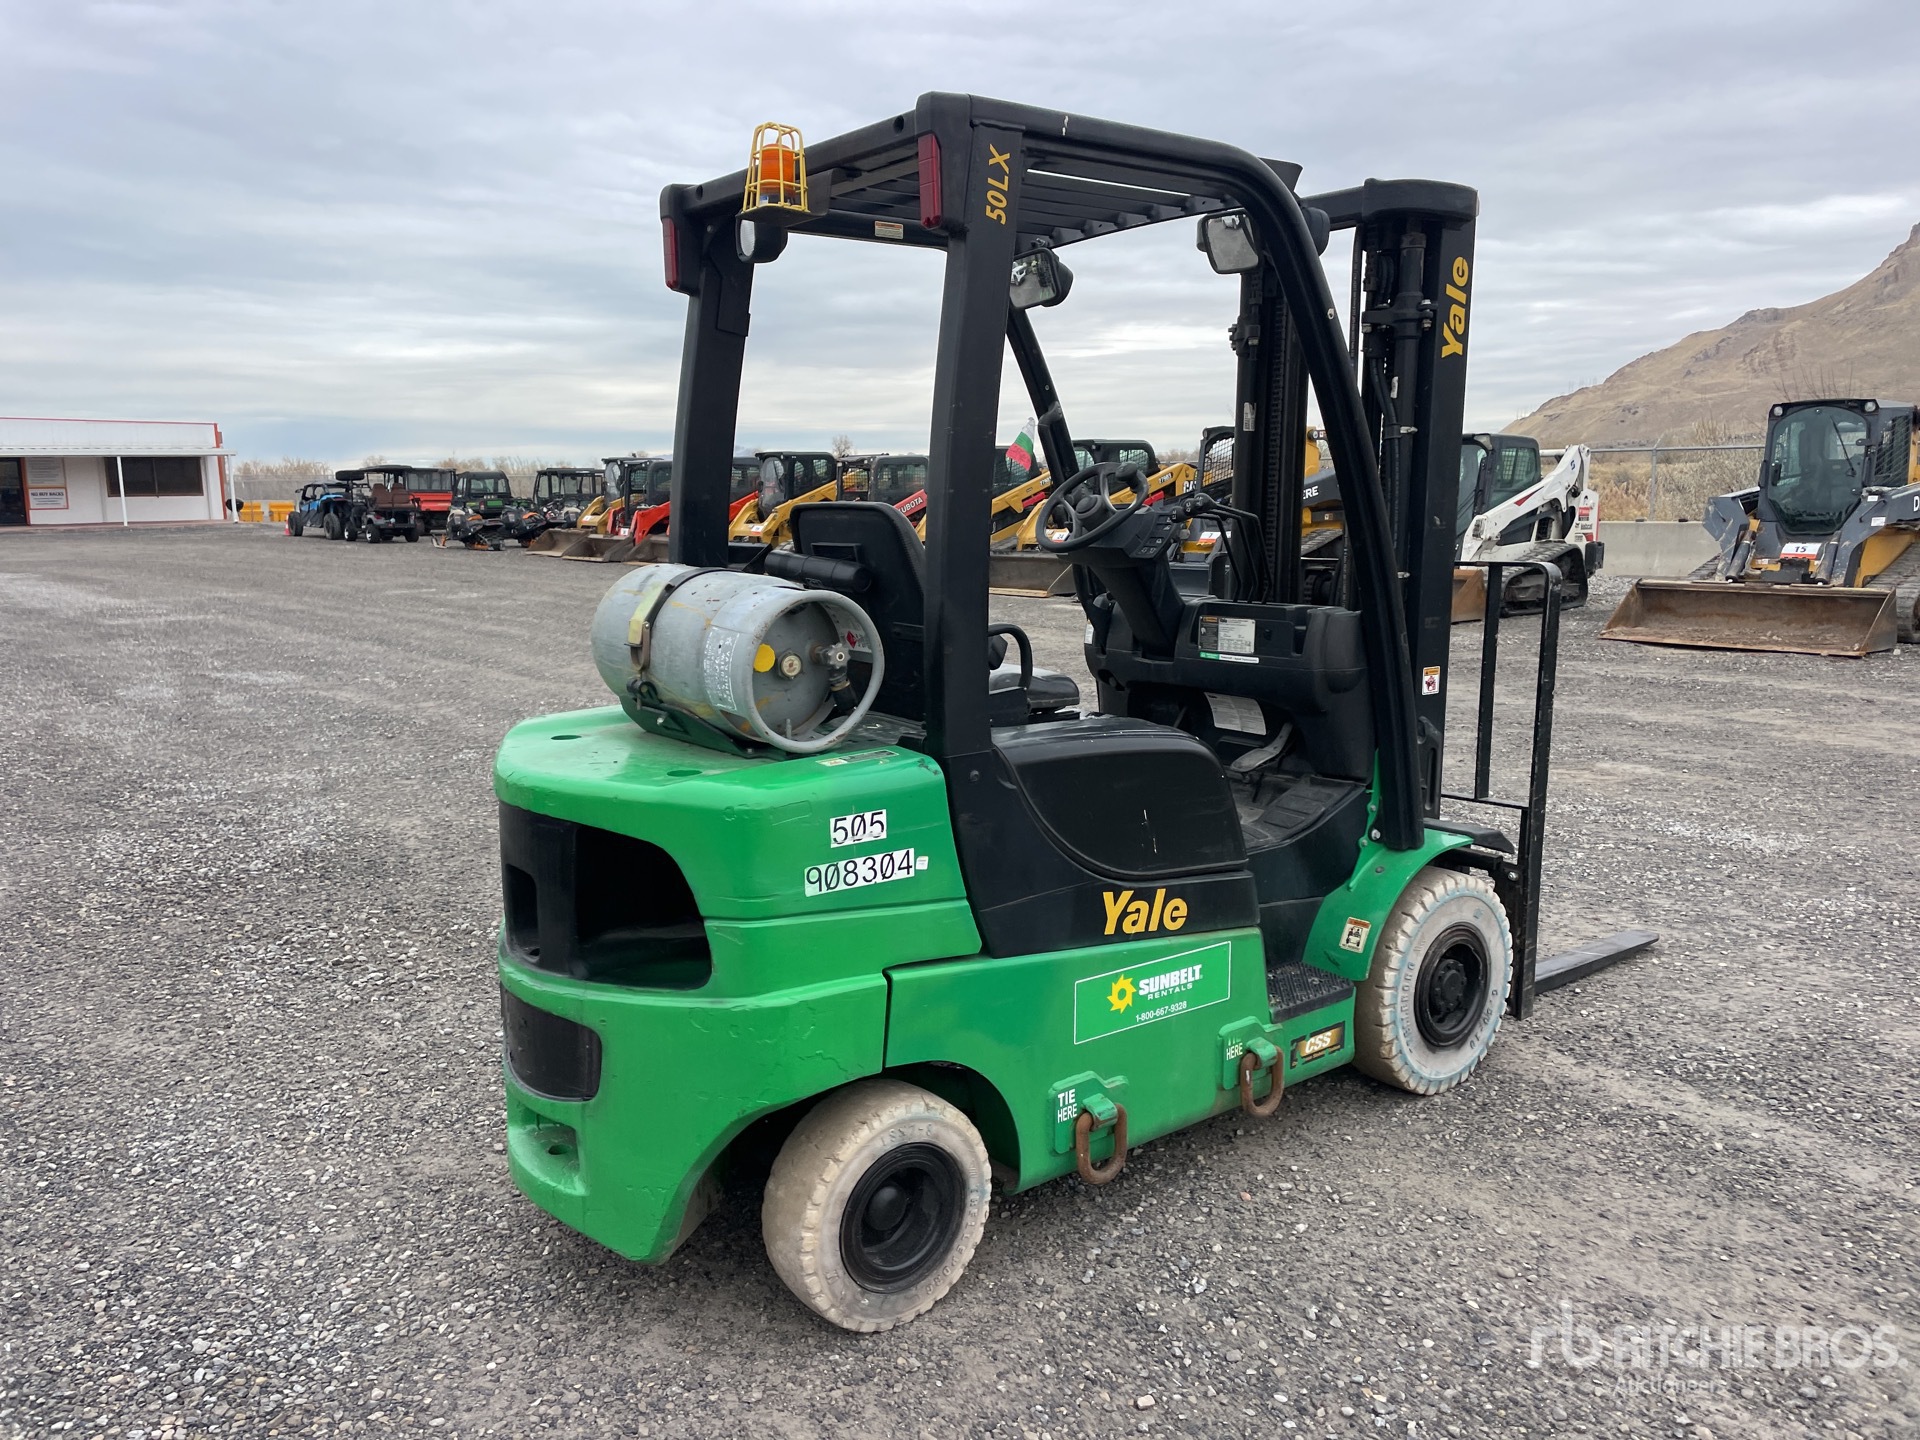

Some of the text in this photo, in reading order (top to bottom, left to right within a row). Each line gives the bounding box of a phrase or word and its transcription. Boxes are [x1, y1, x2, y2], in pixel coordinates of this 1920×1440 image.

[986, 143, 1010, 225] 50LX
[1441, 256, 1470, 359] Yale
[1795, 545, 1807, 553] 15
[832, 810, 885, 846] 505
[806, 849, 914, 893] 908304
[1102, 888, 1188, 936] Yale
[1138, 964, 1202, 996] SUNBELT
[1147, 983, 1193, 1001] RENTALS
[1226, 1042, 1243, 1061] HERE
[1305, 1031, 1332, 1054] CSS
[1058, 1088, 1076, 1106] TIE
[1057, 1103, 1078, 1123] HERE
